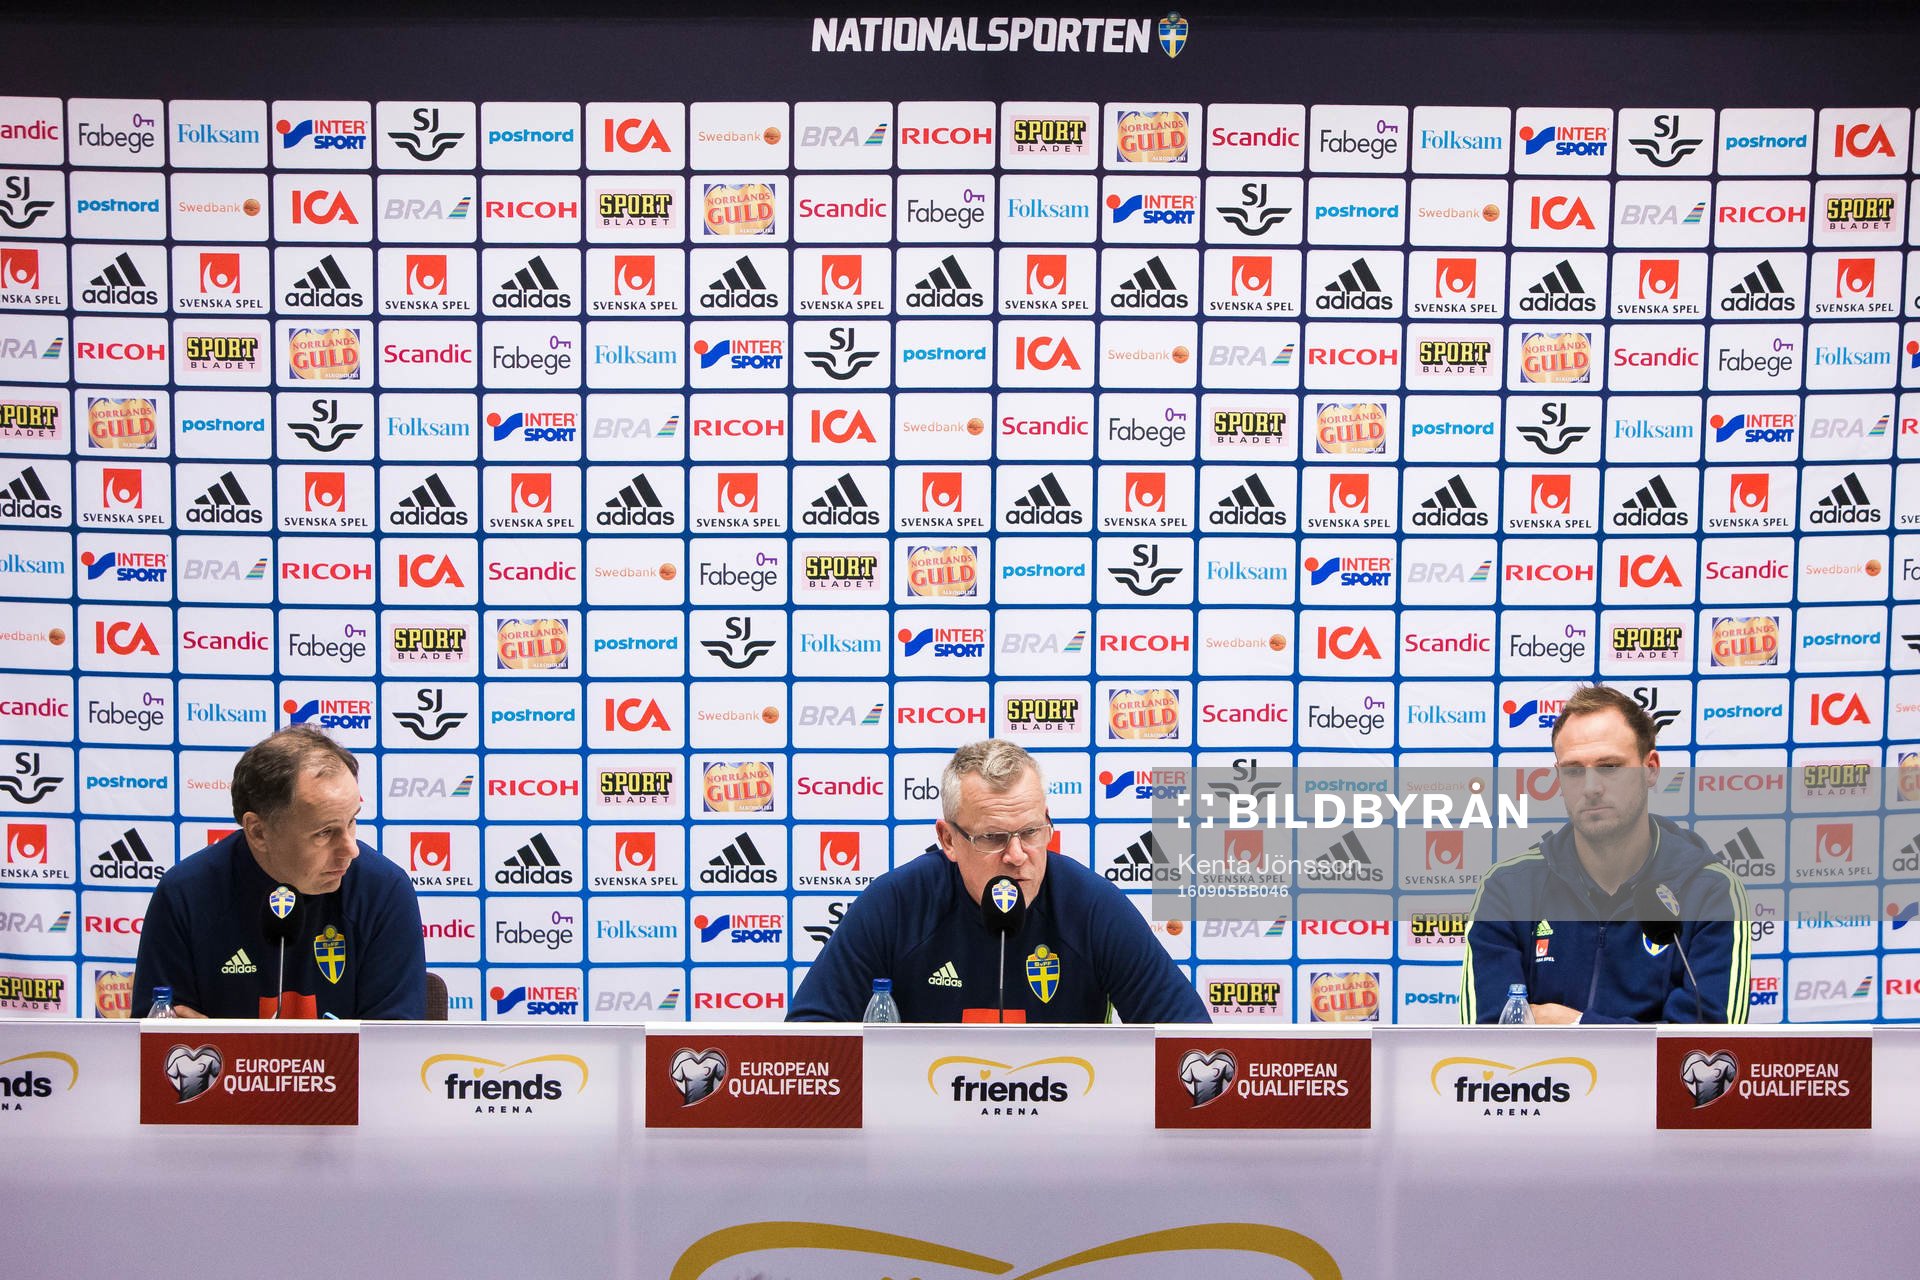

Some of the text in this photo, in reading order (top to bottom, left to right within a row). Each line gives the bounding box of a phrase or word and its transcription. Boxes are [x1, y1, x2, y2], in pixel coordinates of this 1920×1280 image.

[812, 17, 1152, 54] NATIONALSPORTEN
[315, 120, 366, 137] INTER
[413, 108, 438, 132] SJ
[1121, 120, 1184, 134] NORRLANDS
[79, 123, 154, 153] Fabege
[178, 124, 259, 143] Folksam
[489, 129, 574, 144] postnord
[699, 132, 759, 141] Swedbank
[801, 127, 859, 146] BRA
[902, 128, 992, 144] RICOH
[1119, 129, 1187, 153] GULD
[1422, 130, 1502, 149] Folksam
[1556, 126, 1606, 141] INTER
[1726, 134, 1807, 150] postnord
[1835, 124, 1895, 158] ICA
[314, 137, 366, 149] SPORT
[1321, 130, 1397, 159] Fabege
[1556, 143, 1607, 156] SPORT
[1242, 183, 1267, 207] SJ
[179, 202, 240, 212] Swedbank
[292, 190, 358, 224] ICA
[600, 194, 672, 218] SPORT
[800, 198, 886, 217] Scandic
[1008, 199, 1089, 218] Folksam
[1621, 205, 1677, 224] BRA
[1719, 206, 1806, 223] RICOH
[1827, 198, 1894, 222] SPORT
[386, 301, 470, 309] SVENSKA SPEL
[1415, 304, 1497, 312] SVENSKA SPEL
[1618, 305, 1699, 313] SVENSKA SPEL
[78, 342, 165, 360] RICOH
[187, 337, 258, 361] SPORT
[384, 344, 471, 363] Scandic
[596, 345, 676, 364] Folksam
[731, 340, 782, 357] INTER
[903, 347, 986, 362] postnord
[1108, 350, 1168, 360] Swedbank
[1309, 348, 1397, 365] RICOH
[1525, 341, 1587, 354] NORRLANDS
[1615, 347, 1698, 366] Scandic
[1816, 347, 1890, 365] Folksam
[191, 361, 255, 369] BLADET
[731, 356, 783, 369] SPORT
[1523, 349, 1590, 373] GULD
[1719, 349, 1792, 376] Fabege
[92, 406, 153, 420] NORRLANDS
[313, 400, 337, 423] SJ
[91, 415, 155, 439] GULD
[182, 418, 265, 432] postnord
[524, 413, 575, 430] INTER
[593, 418, 651, 438] BRA
[694, 420, 784, 436] RICOH
[811, 409, 876, 443] ICA
[1215, 412, 1285, 436] SPORT
[1412, 422, 1494, 437] postnord
[1616, 420, 1693, 438] Folksam
[1745, 414, 1794, 431] INTER
[524, 429, 576, 441] SPORT
[1110, 418, 1185, 447] Fabege
[1745, 430, 1794, 442] SPORT
[186, 504, 262, 523] adidas
[597, 506, 674, 525] adidas
[902, 518, 983, 526] SVENSKA SPEL
[1006, 505, 1082, 524] adidas
[1810, 504, 1880, 523] adidas
[1510, 520, 1591, 528] SVENSKA SPEL
[118, 553, 166, 569] INTER
[911, 554, 973, 568] NORRLANDS
[1341, 557, 1390, 574] INTER
[1806, 565, 1862, 574] Swedbank
[117, 569, 167, 582] SPORT
[399, 554, 464, 588] ICA
[701, 563, 777, 591] Fabege
[910, 563, 975, 586] GULD
[1341, 573, 1391, 586] SPORT
[1408, 563, 1464, 582] BRA
[1620, 554, 1682, 588] ICA
[501, 627, 564, 641] NORRLANDS
[726, 617, 750, 640] SJ
[1715, 624, 1775, 638] NORRLANDS
[96, 621, 160, 656] ICA
[183, 631, 268, 650] Scandic
[500, 636, 566, 659] GULD
[594, 636, 678, 652] postnord
[802, 634, 881, 652] Folksam
[1100, 635, 1189, 651] RICOH
[1613, 628, 1682, 651] SPORT
[1713, 633, 1777, 656] GULD
[1803, 632, 1881, 648] postnord
[290, 634, 365, 663] Fabege
[1511, 635, 1584, 662] Fabege
[187, 703, 266, 722] Folksam
[698, 711, 758, 720] Swedbank
[799, 706, 856, 725] BRA
[1203, 704, 1287, 722] Scandic
[1408, 705, 1486, 724] Folksam
[1811, 692, 1871, 726] ICA
[86, 776, 168, 789] postnord
[389, 778, 446, 797] BRA
[489, 780, 578, 796] RICOH
[601, 772, 672, 795] SPORT
[495, 865, 572, 884] adidas
[595, 877, 677, 885] SVENSKA SPEL
[597, 920, 677, 939] Folksam
[731, 915, 781, 931] INTER
[497, 922, 572, 949] Fabege
[731, 930, 782, 943] SPORT
[221, 963, 257, 974] adidas
[0, 976, 64, 1002] SPORT
[928, 976, 963, 988] adidas
[1313, 981, 1376, 994] NORRLANDS
[1794, 980, 1847, 1000] BRA
[528, 987, 577, 1001] INTER
[595, 992, 651, 1011] BRA
[694, 993, 784, 1009] RICOH
[1210, 983, 1280, 1006] SPORT
[1314, 991, 1378, 1012] GULD
[2, 1001, 61, 1010] BLADET
[527, 1002, 578, 1015] SPORT
[236, 1059, 325, 1073] EUROPEAN
[741, 1062, 829, 1076] EUROPEAN
[1250, 1063, 1338, 1077] EUROPEAN
[1751, 1064, 1839, 1078] EUROPEAN
[224, 1076, 337, 1095] QUALIFIERS
[445, 1073, 562, 1100] friends
[729, 1079, 841, 1098] QUALIFIERS
[952, 1075, 1067, 1102] friends
[1238, 1080, 1349, 1099] QUALIFIERS
[1455, 1077, 1570, 1103] friends
[1740, 1080, 1850, 1100] QUALIFIERS
[476, 1105, 533, 1114] ARENA
[981, 1107, 1039, 1116] ARENA
[1484, 1108, 1541, 1116] ARENA
